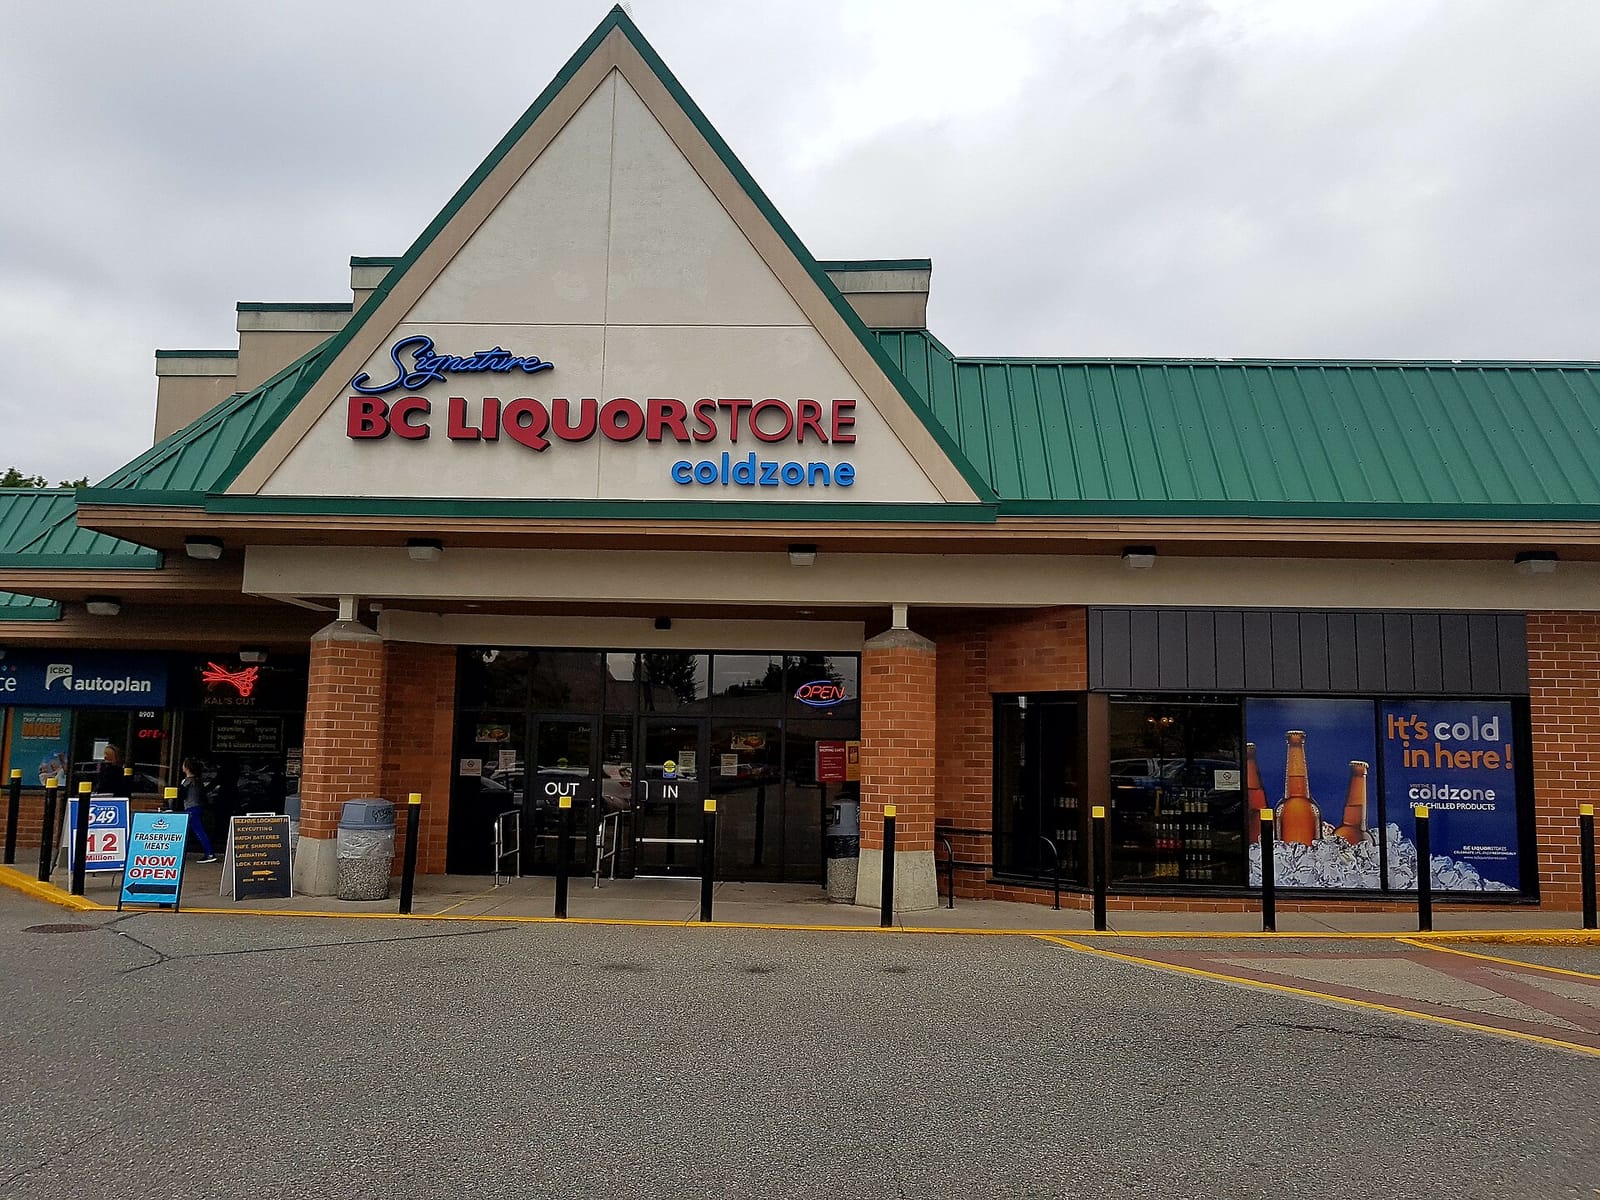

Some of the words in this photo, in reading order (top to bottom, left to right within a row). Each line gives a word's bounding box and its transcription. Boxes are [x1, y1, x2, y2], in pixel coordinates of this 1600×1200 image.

[351, 335, 554, 394] Signature
[347, 396, 431, 440] BC
[671, 451, 856, 486] coldzone
[74, 677, 151, 694] autoplan
[799, 685, 846, 698] OPEN
[1388, 713, 1429, 740] It's
[1433, 715, 1499, 741] cold
[1403, 741, 1430, 768] in
[544, 782, 580, 796] OUT
[662, 784, 679, 798] IN
[1408, 784, 1496, 801] coldzone
[1425, 802, 1455, 810] CHILLED
[1456, 803, 1496, 811] PRODUCTS
[134, 833, 182, 842] FRASERVIEW
[144, 842, 170, 850] MEATS
[135, 856, 176, 866] NOW
[129, 868, 177, 879] OPEN
